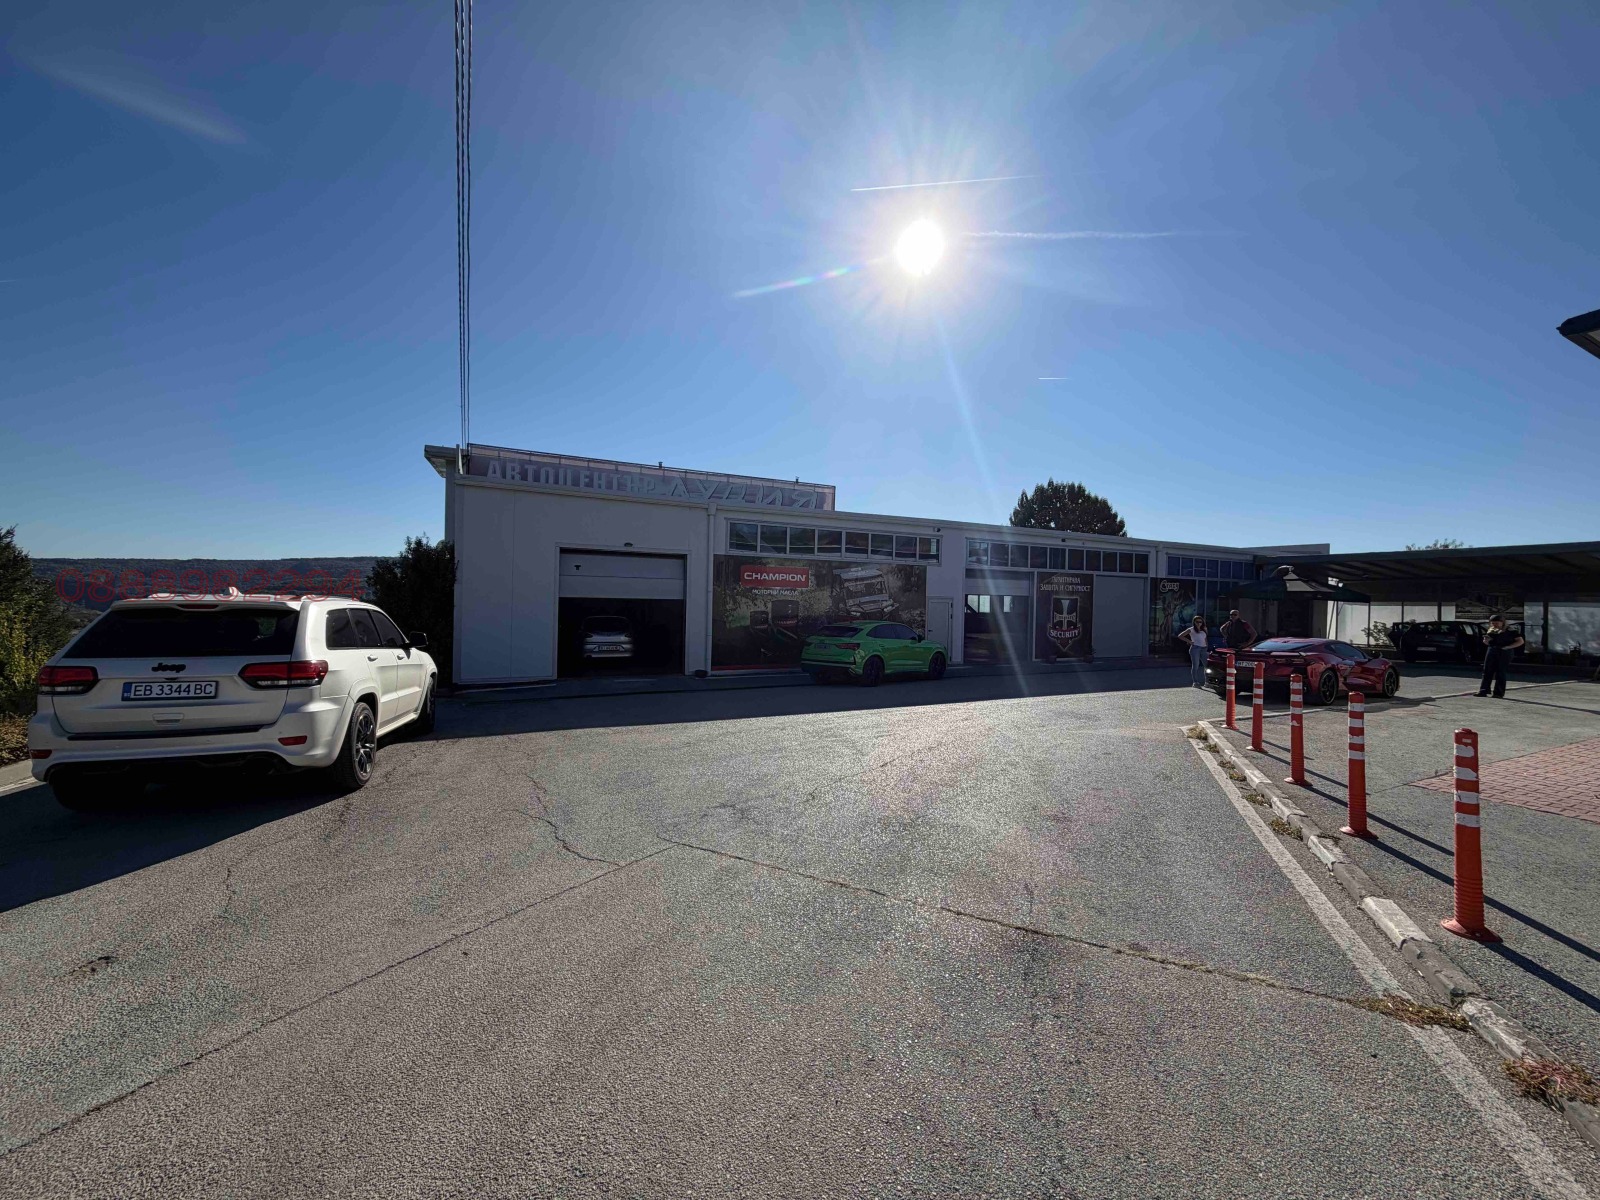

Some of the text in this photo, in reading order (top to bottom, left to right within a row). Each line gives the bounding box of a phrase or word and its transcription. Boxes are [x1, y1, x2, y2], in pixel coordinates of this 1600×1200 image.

[744, 572, 806, 582] CHAMPION
[1050, 629, 1079, 638] SECURITY
[151, 663, 186, 673] Jeep
[133, 684, 153, 697] EB
[155, 684, 191, 696] 3344
[193, 683, 213, 695] BC
